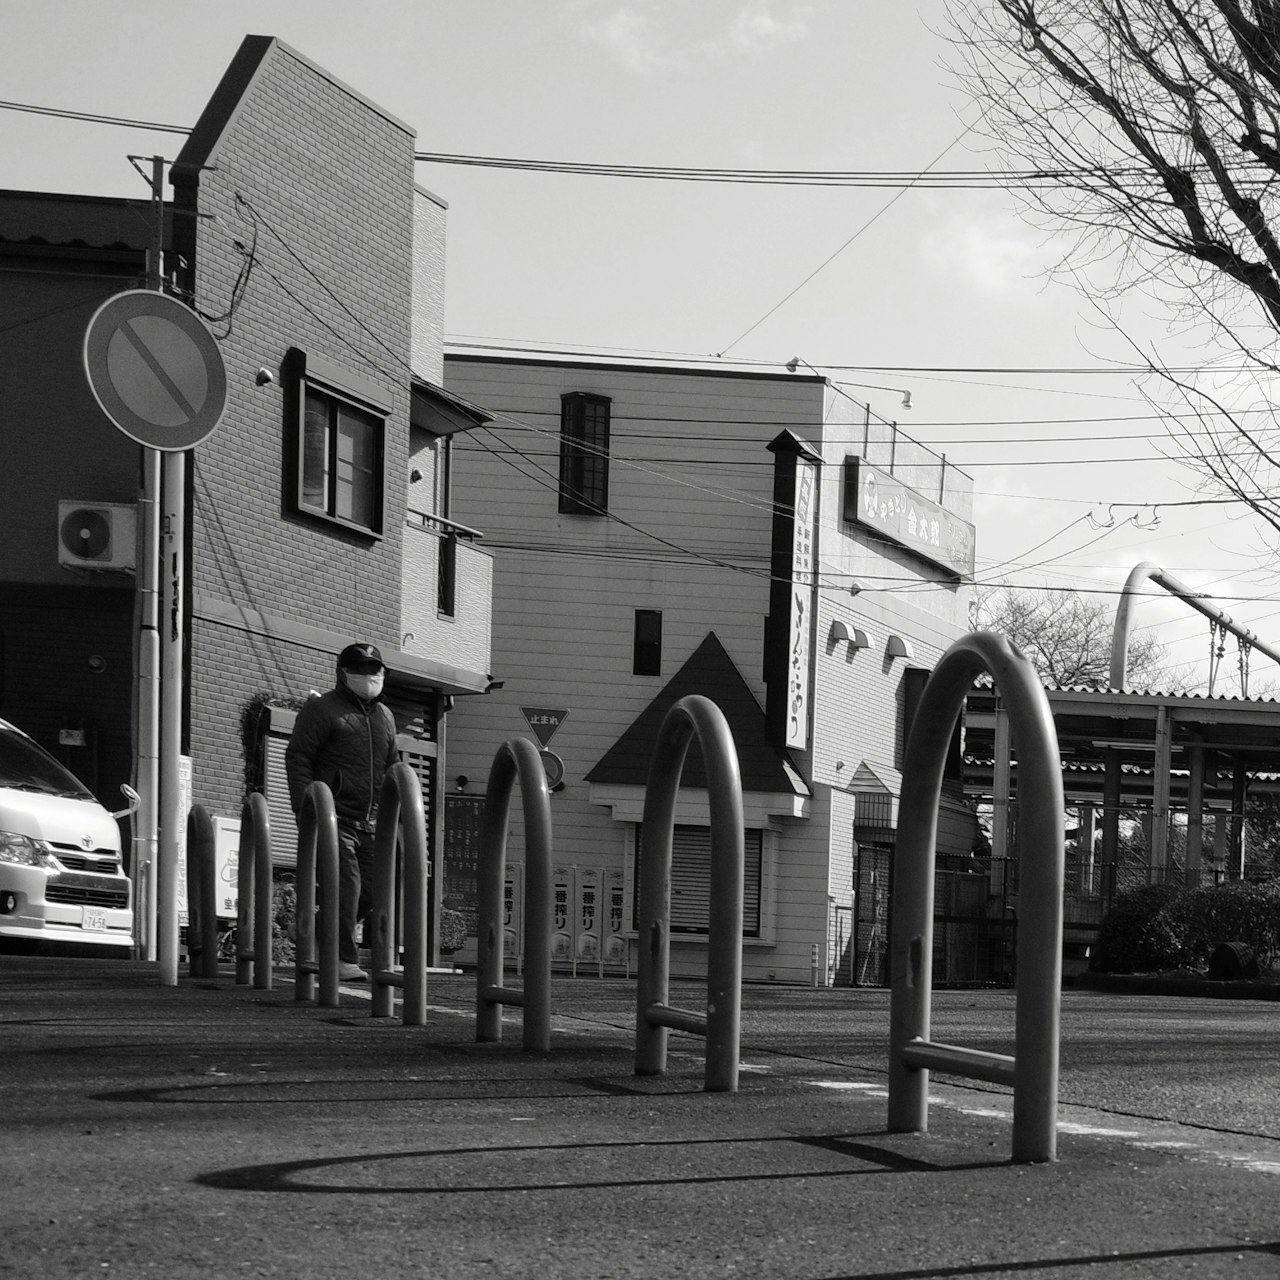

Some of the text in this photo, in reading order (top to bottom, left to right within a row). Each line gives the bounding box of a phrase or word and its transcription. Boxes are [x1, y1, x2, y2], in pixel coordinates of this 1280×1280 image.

[530, 714, 559, 725] 止まれ
[555, 883, 568, 930] 一番搾り
[582, 885, 595, 931] 一番搾り
[610, 887, 624, 932] 一番搾り
